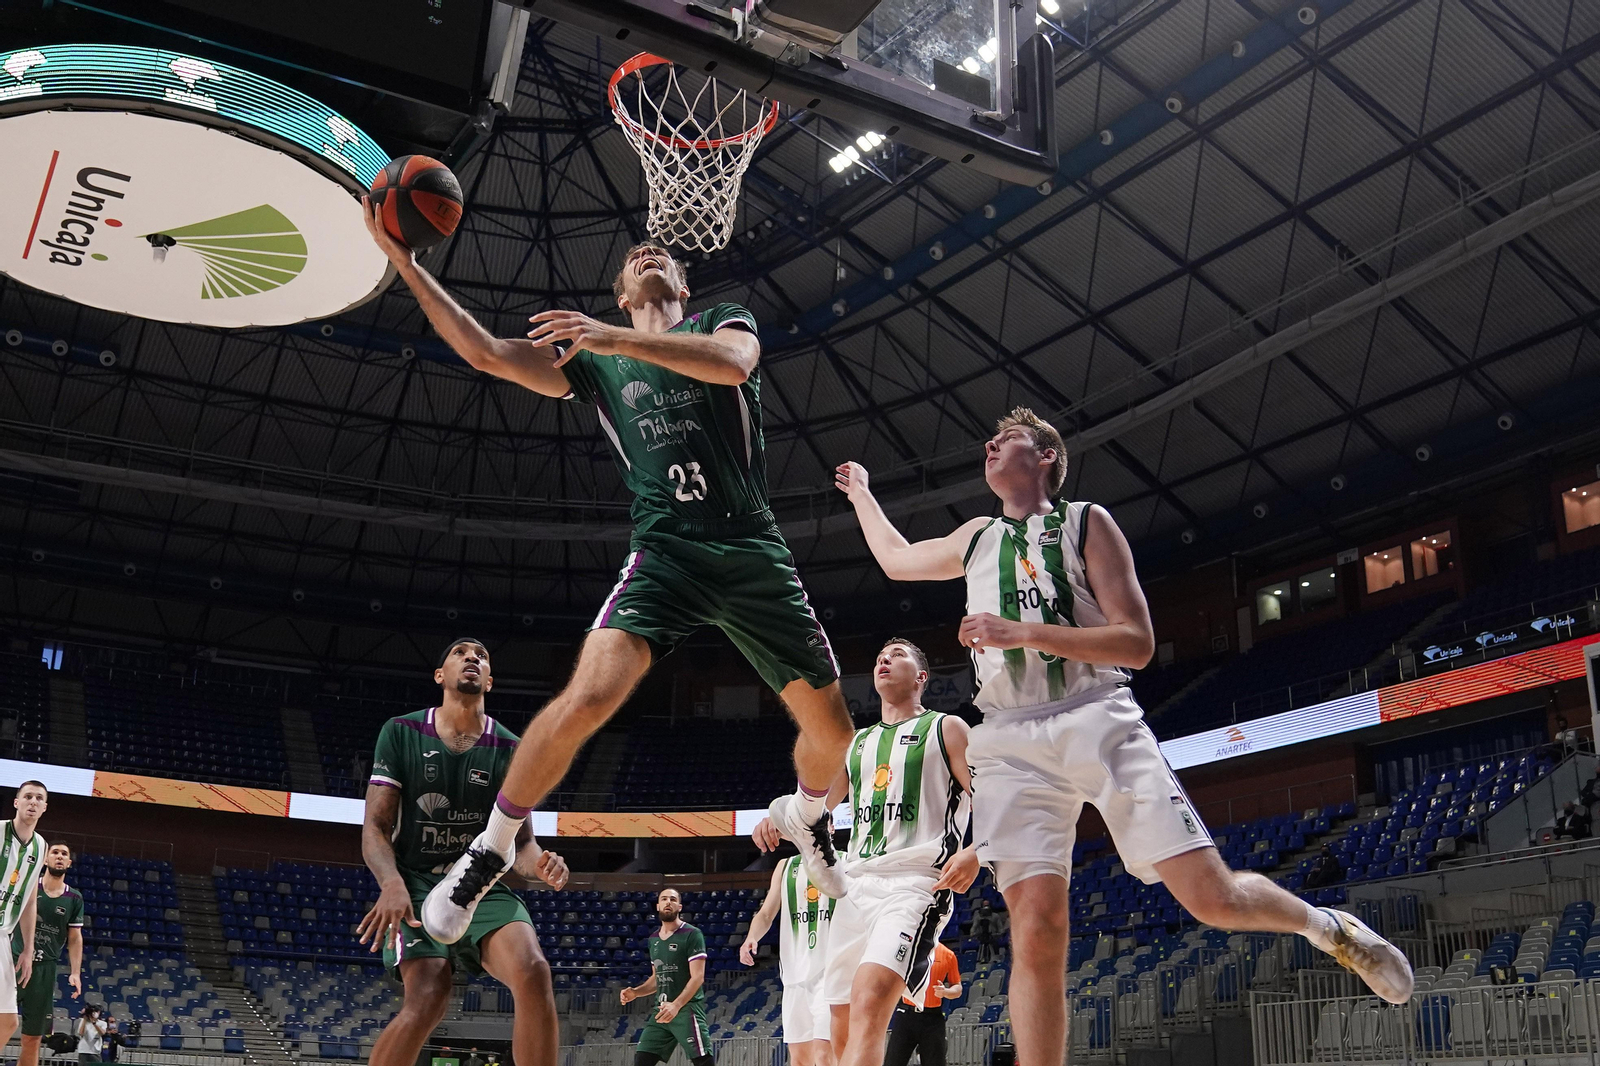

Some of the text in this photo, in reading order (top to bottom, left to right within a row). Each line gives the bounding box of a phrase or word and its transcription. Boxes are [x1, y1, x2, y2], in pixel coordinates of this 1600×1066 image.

[39, 166, 132, 268] Unicaja
[653, 384, 705, 407] Unicaja
[637, 415, 702, 441] Málaga
[668, 461, 708, 503] 23
[1493, 631, 1518, 644] Unicaja
[1439, 645, 1463, 658] Unicaja
[1215, 741, 1254, 758] ANARTEC
[859, 834, 887, 859] 44
[807, 930, 818, 950] 0
